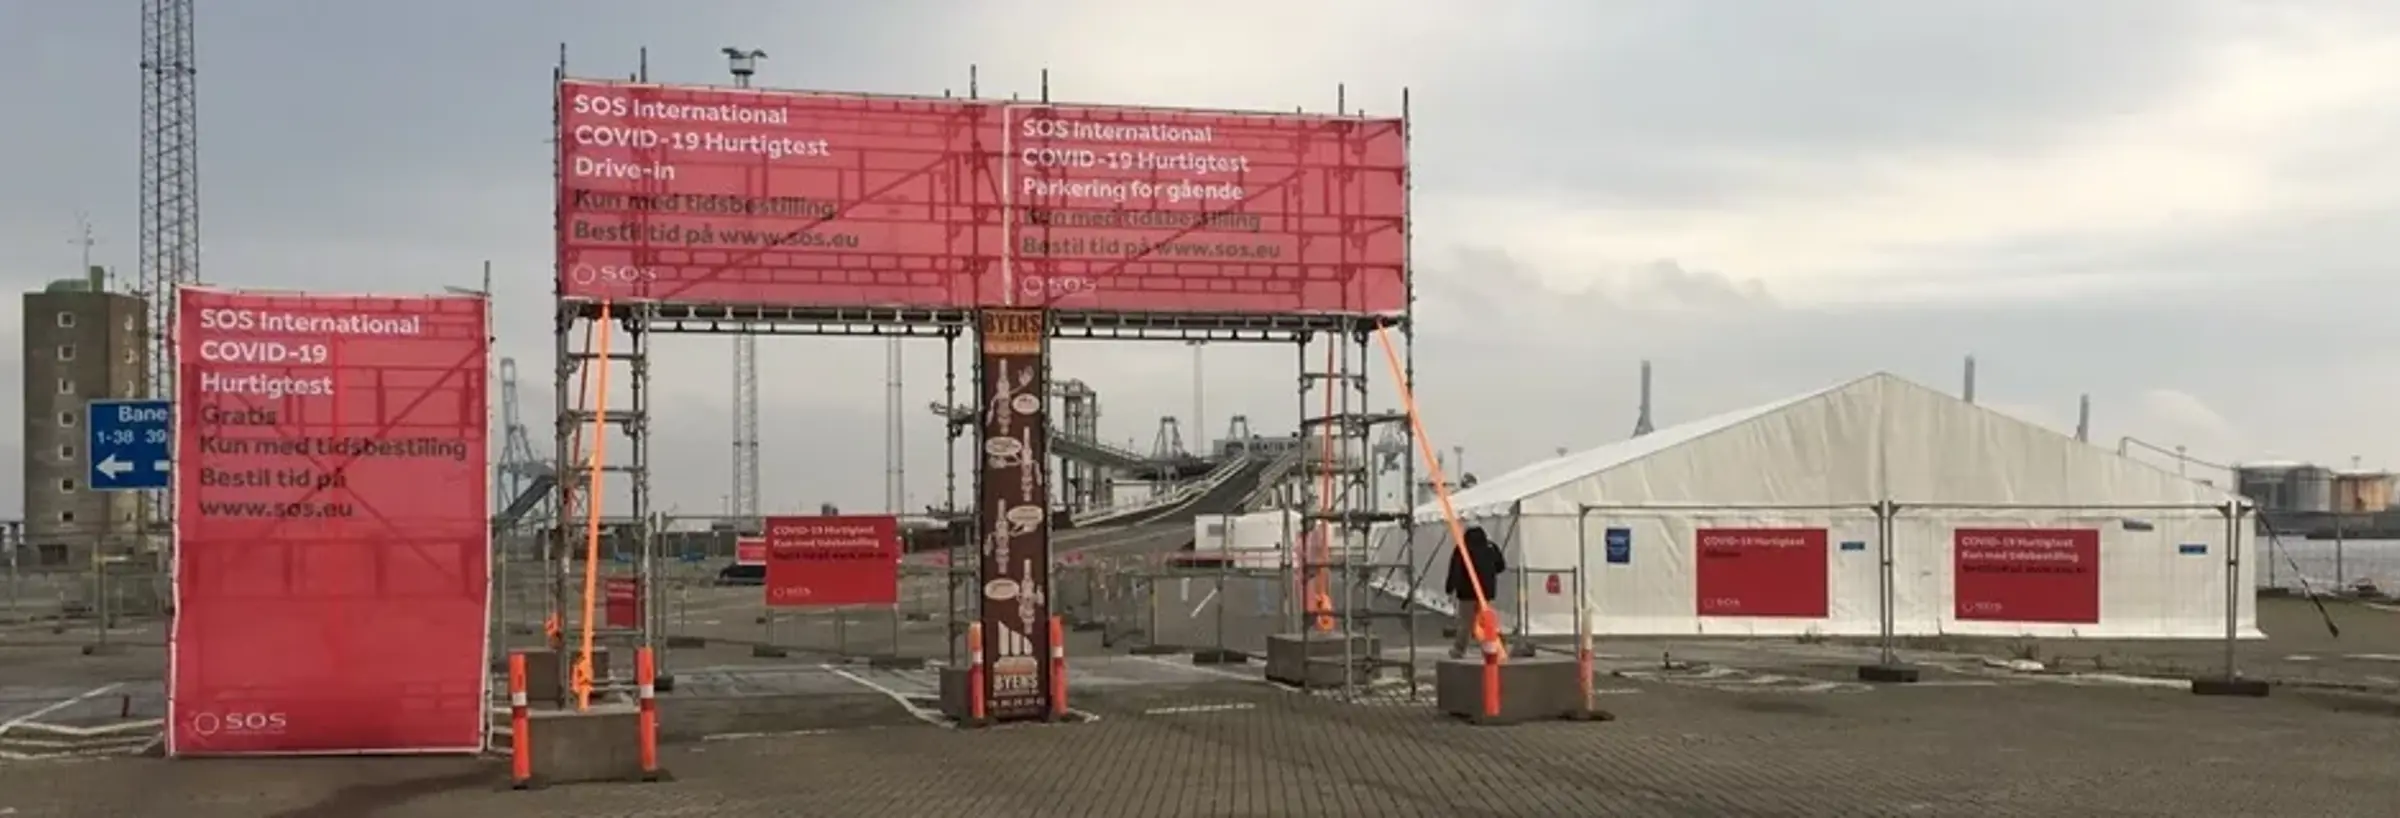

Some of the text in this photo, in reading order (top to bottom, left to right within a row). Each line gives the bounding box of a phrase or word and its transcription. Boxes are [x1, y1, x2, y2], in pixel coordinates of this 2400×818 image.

[574, 94, 788, 125] SOS International
[1023, 118, 1212, 142] SOS International
[575, 124, 830, 159] COVID-19 Hurtigtest
[575, 156, 675, 181] Drive-in
[1022, 147, 1250, 175] COVID-19 Hurtigtest
[1023, 176, 1244, 202] Parkering for gående
[575, 189, 836, 220] Kun med tidsbestilling
[1024, 209, 1067, 226] Kun
[1071, 209, 1116, 226] med
[575, 220, 859, 248] Bestil tid på www.sos.eu
[1023, 236, 1281, 259] Bestil tid på www.sos.eu
[600, 265, 657, 282] SOS
[1048, 277, 1097, 291] SOS
[201, 308, 420, 335] SOS International
[984, 314, 1041, 333] BYENS
[200, 340, 327, 364] COVID-19
[200, 372, 334, 398] Hurtigtest
[118, 405, 168, 422] Bane
[201, 405, 277, 425] Gratis
[97, 429, 167, 445] 1-38 39
[200, 436, 248, 454] Kun
[254, 436, 309, 455] med
[200, 468, 346, 490] Bestil tid på
[200, 502, 353, 518] www.sos.eu
[772, 525, 875, 537] COVID-19 Hurtigtest
[226, 712, 286, 730] SOS
